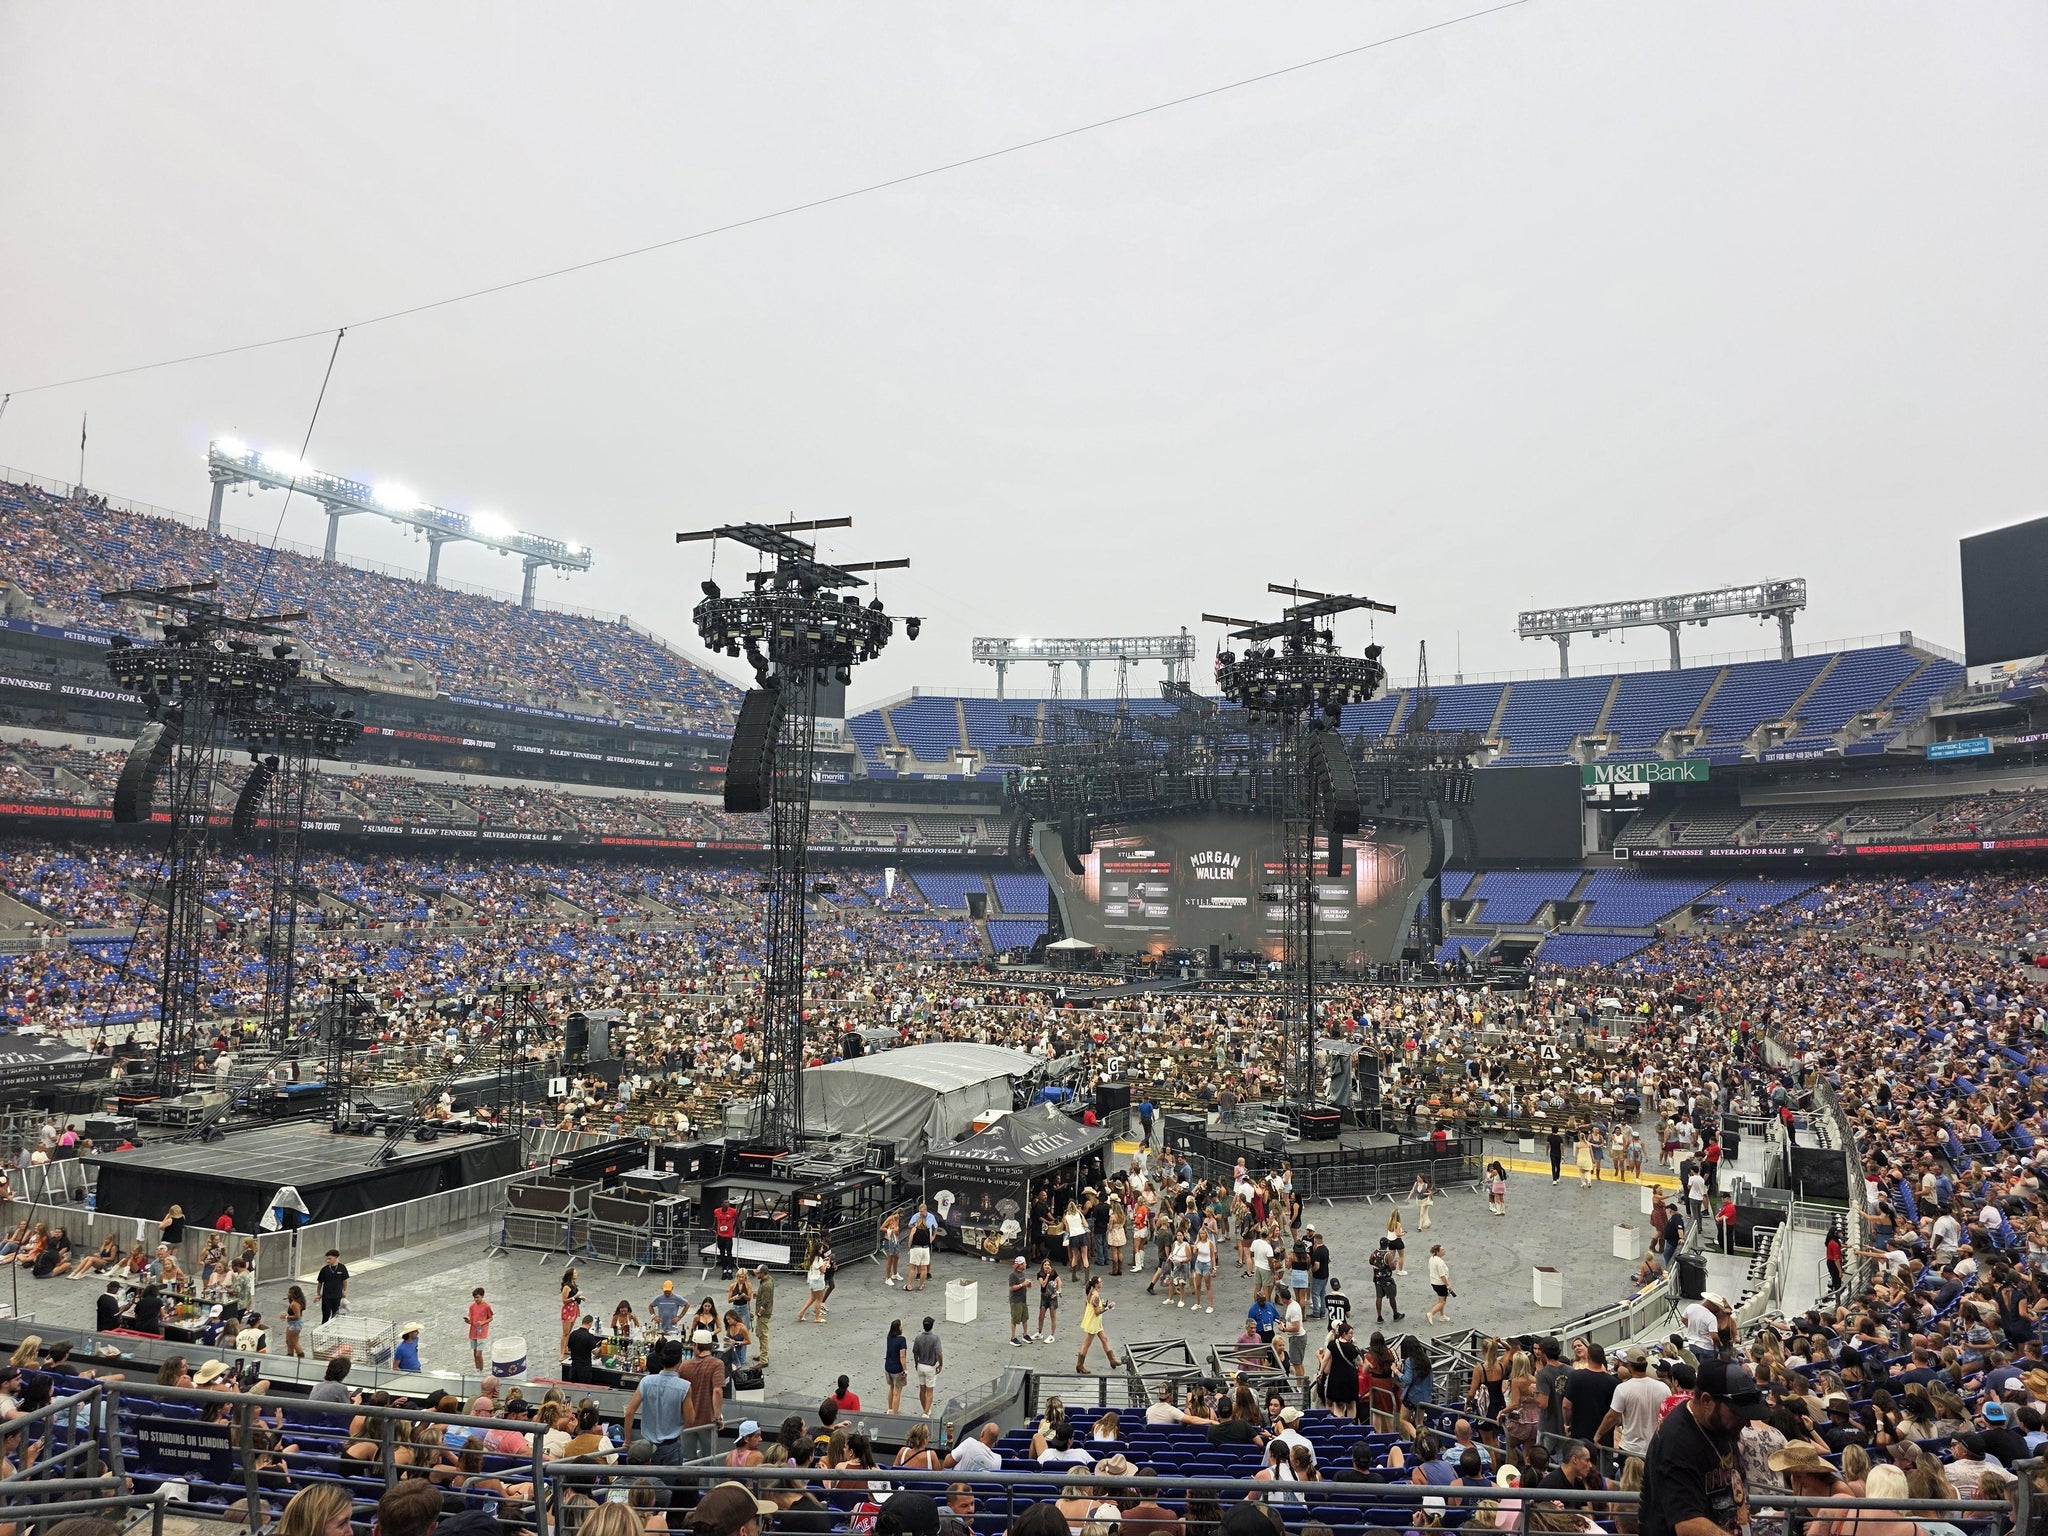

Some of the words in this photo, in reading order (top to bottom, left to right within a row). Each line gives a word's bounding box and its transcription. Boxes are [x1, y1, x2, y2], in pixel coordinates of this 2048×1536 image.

[64, 630, 86, 642] PETER
[88, 635, 112, 646] BOULW
[60, 686, 114, 700] SILVERADO
[116, 694, 135, 702] FOR
[462, 698, 480, 706] STOVER
[382, 728, 395, 736] TEXT
[428, 734, 441, 742] SONG
[516, 746, 544, 754] SUMMERS
[572, 752, 602, 760] TENNESSEE
[606, 756, 634, 764] SILVERADO
[822, 773, 844, 781] merritt
[1594, 764, 1644, 783] M&T
[1646, 762, 1706, 781] Bank
[23, 806, 46, 815] SONG
[48, 806, 60, 816] DO
[60, 808, 76, 817] YOU
[78, 808, 100, 818] WANT
[102, 810, 112, 819] TO
[368, 826, 403, 834] SUMMERS
[411, 828, 440, 836] TALKIN'
[440, 829, 478, 838] TENNESSEE
[482, 831, 519, 840] SILVERADO
[1957, 842, 1980, 850] TONIGHT?
[1982, 841, 1996, 849] TEXT
[1190, 850, 1240, 868] MORGAN
[1196, 868, 1234, 880] WALLEN
[1544, 1046, 1554, 1058] A
[1110, 1059, 1117, 1072] G
[554, 1080, 562, 1094] L
[1020, 1132, 1074, 1157] WALLEN
[956, 1162, 980, 1170] PROBLEM
[1328, 1306, 1345, 1321] 20
[139, 1430, 150, 1442] NO
[150, 1432, 185, 1446] STANDING
[186, 1437, 197, 1446] ON
[198, 1437, 229, 1450] LANDING
[159, 1448, 177, 1456] PLEASE
[178, 1450, 190, 1458] KEEP
[190, 1452, 210, 1461] MOVING
